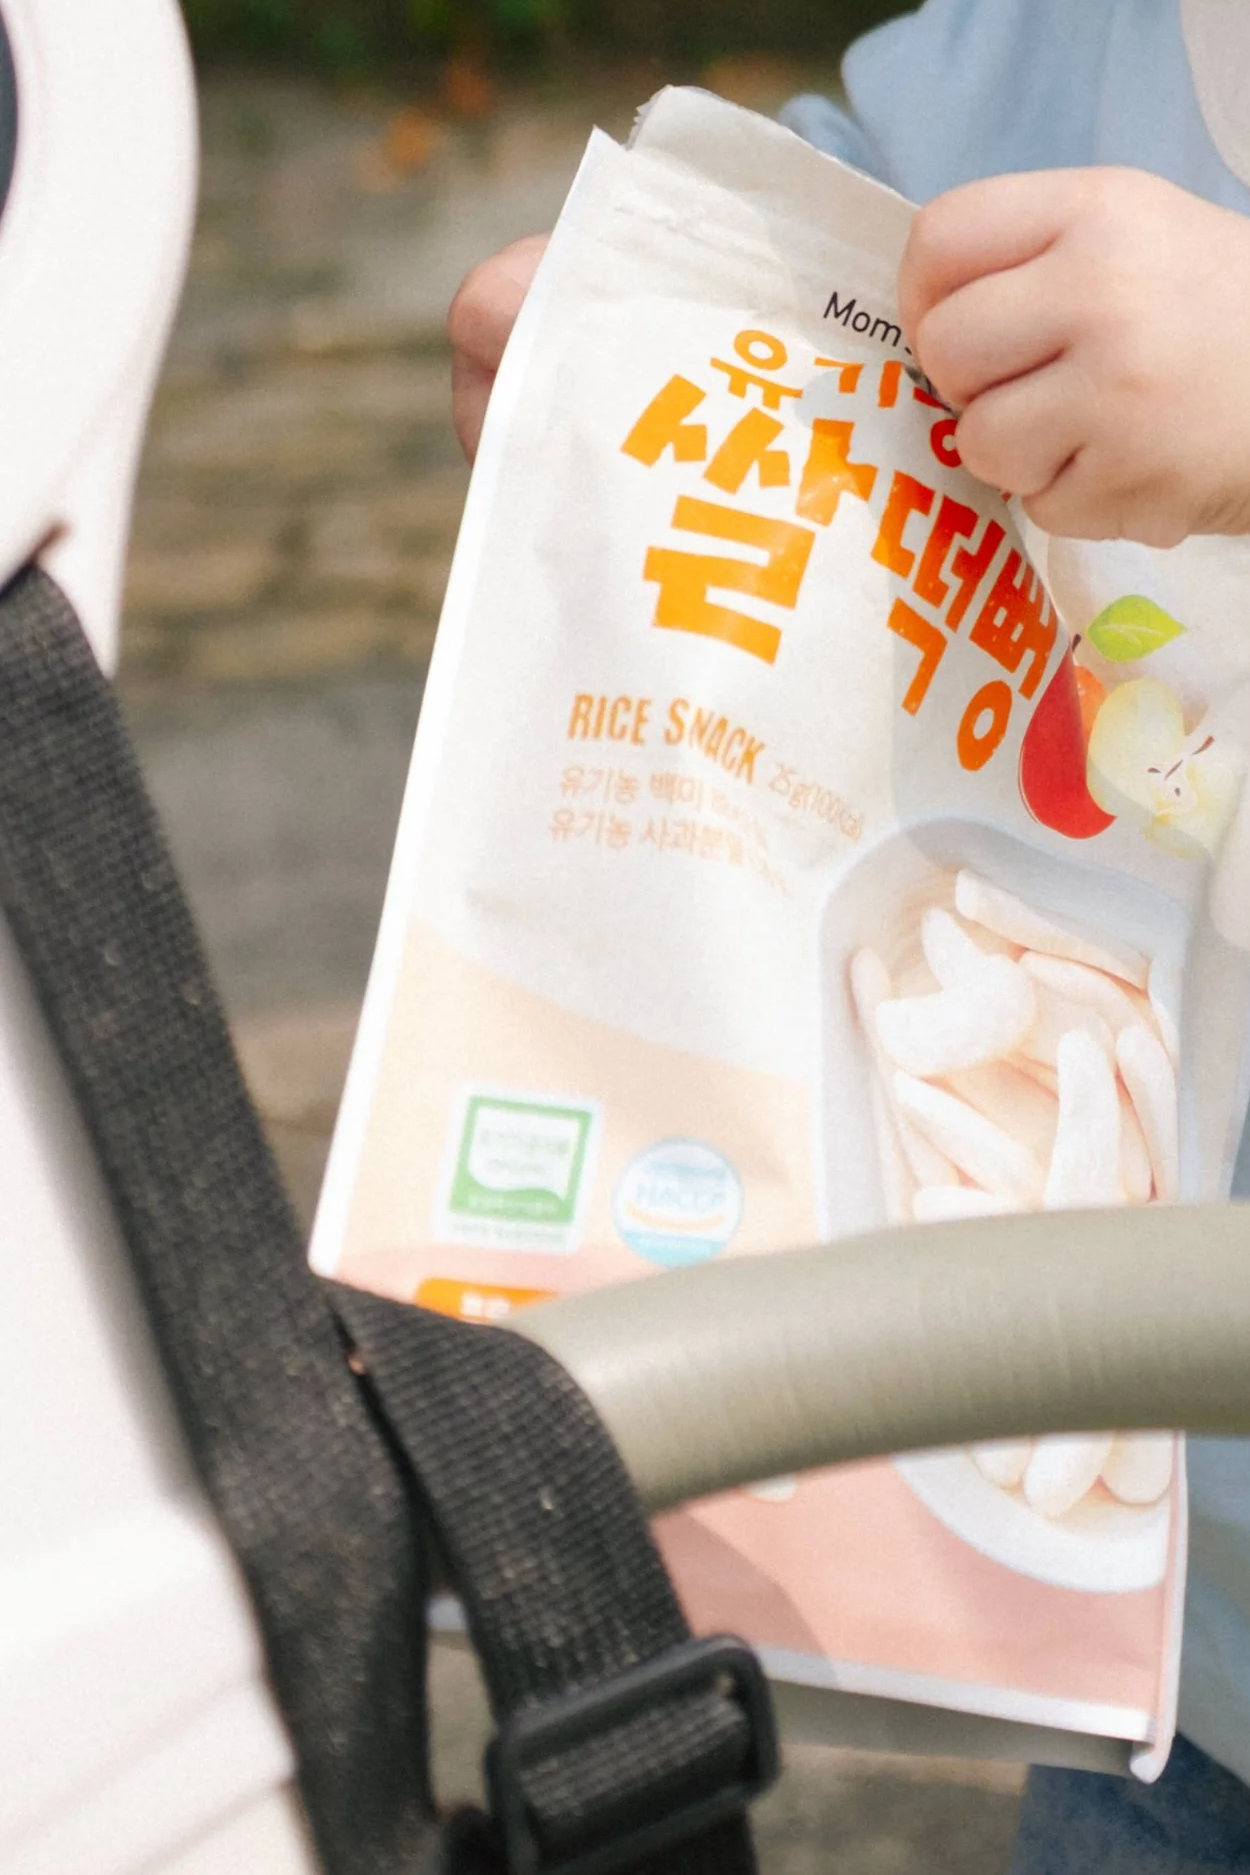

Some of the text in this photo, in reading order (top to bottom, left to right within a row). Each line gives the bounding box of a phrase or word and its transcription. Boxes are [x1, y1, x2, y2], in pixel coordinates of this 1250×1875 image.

[822, 291, 914, 356] Mom
[567, 692, 652, 746] RICE
[664, 698, 766, 784] SNACK
[560, 763, 640, 806] 유기농
[547, 807, 633, 850] 유기농
